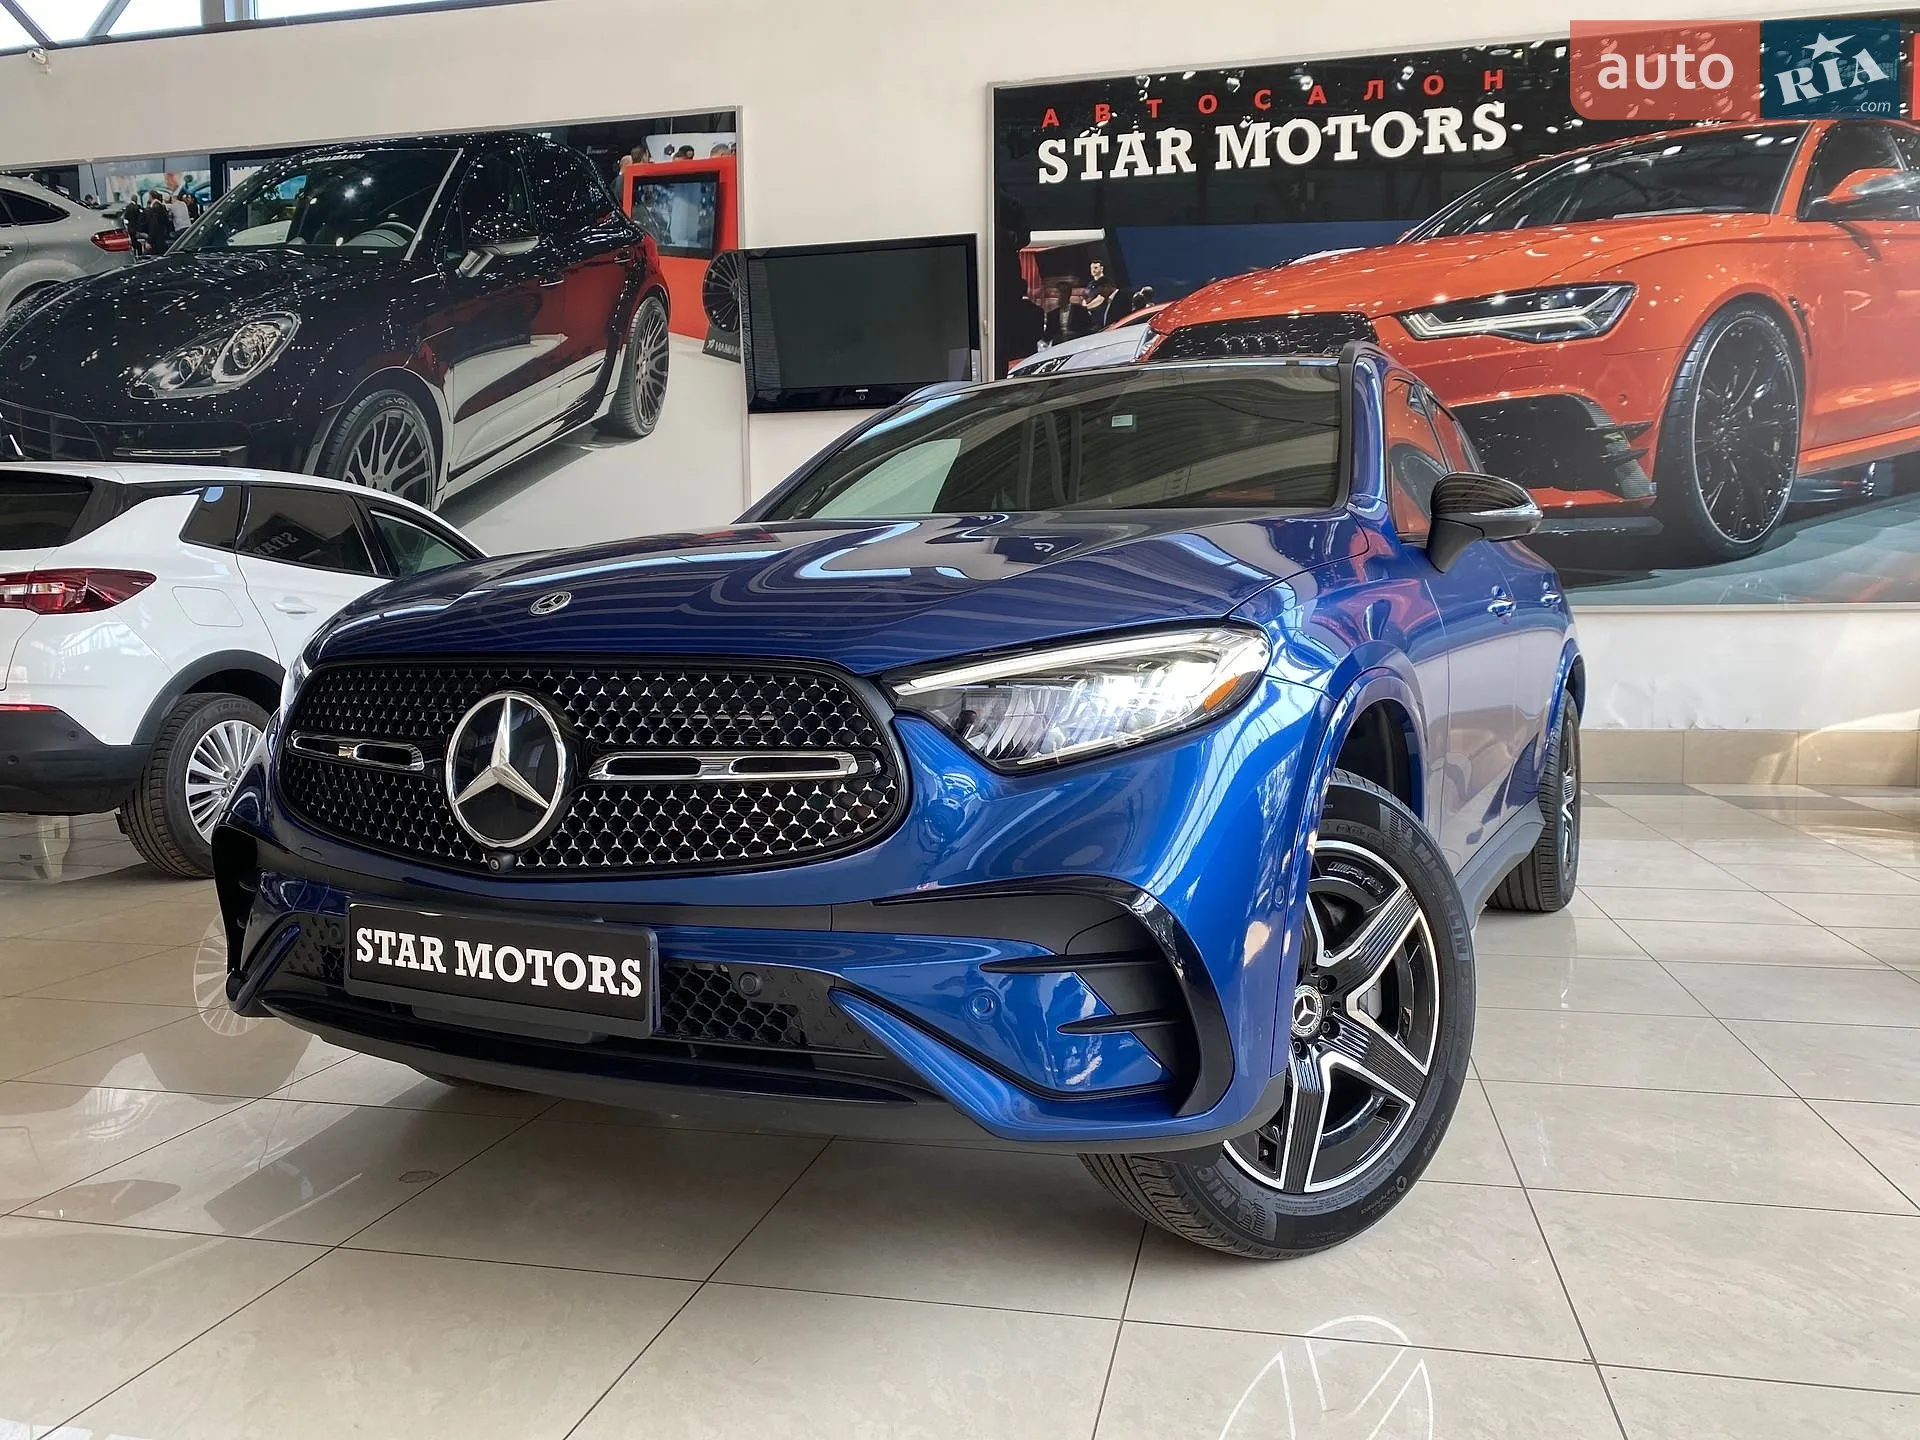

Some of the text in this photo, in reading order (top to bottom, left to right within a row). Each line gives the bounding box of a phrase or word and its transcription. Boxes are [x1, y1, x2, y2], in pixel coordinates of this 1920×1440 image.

[1041, 69, 1504, 128] АВТОСАЛОН
[1038, 101, 1507, 184] STAR MOTORS
[355, 927, 642, 998] STAR MOTORS
